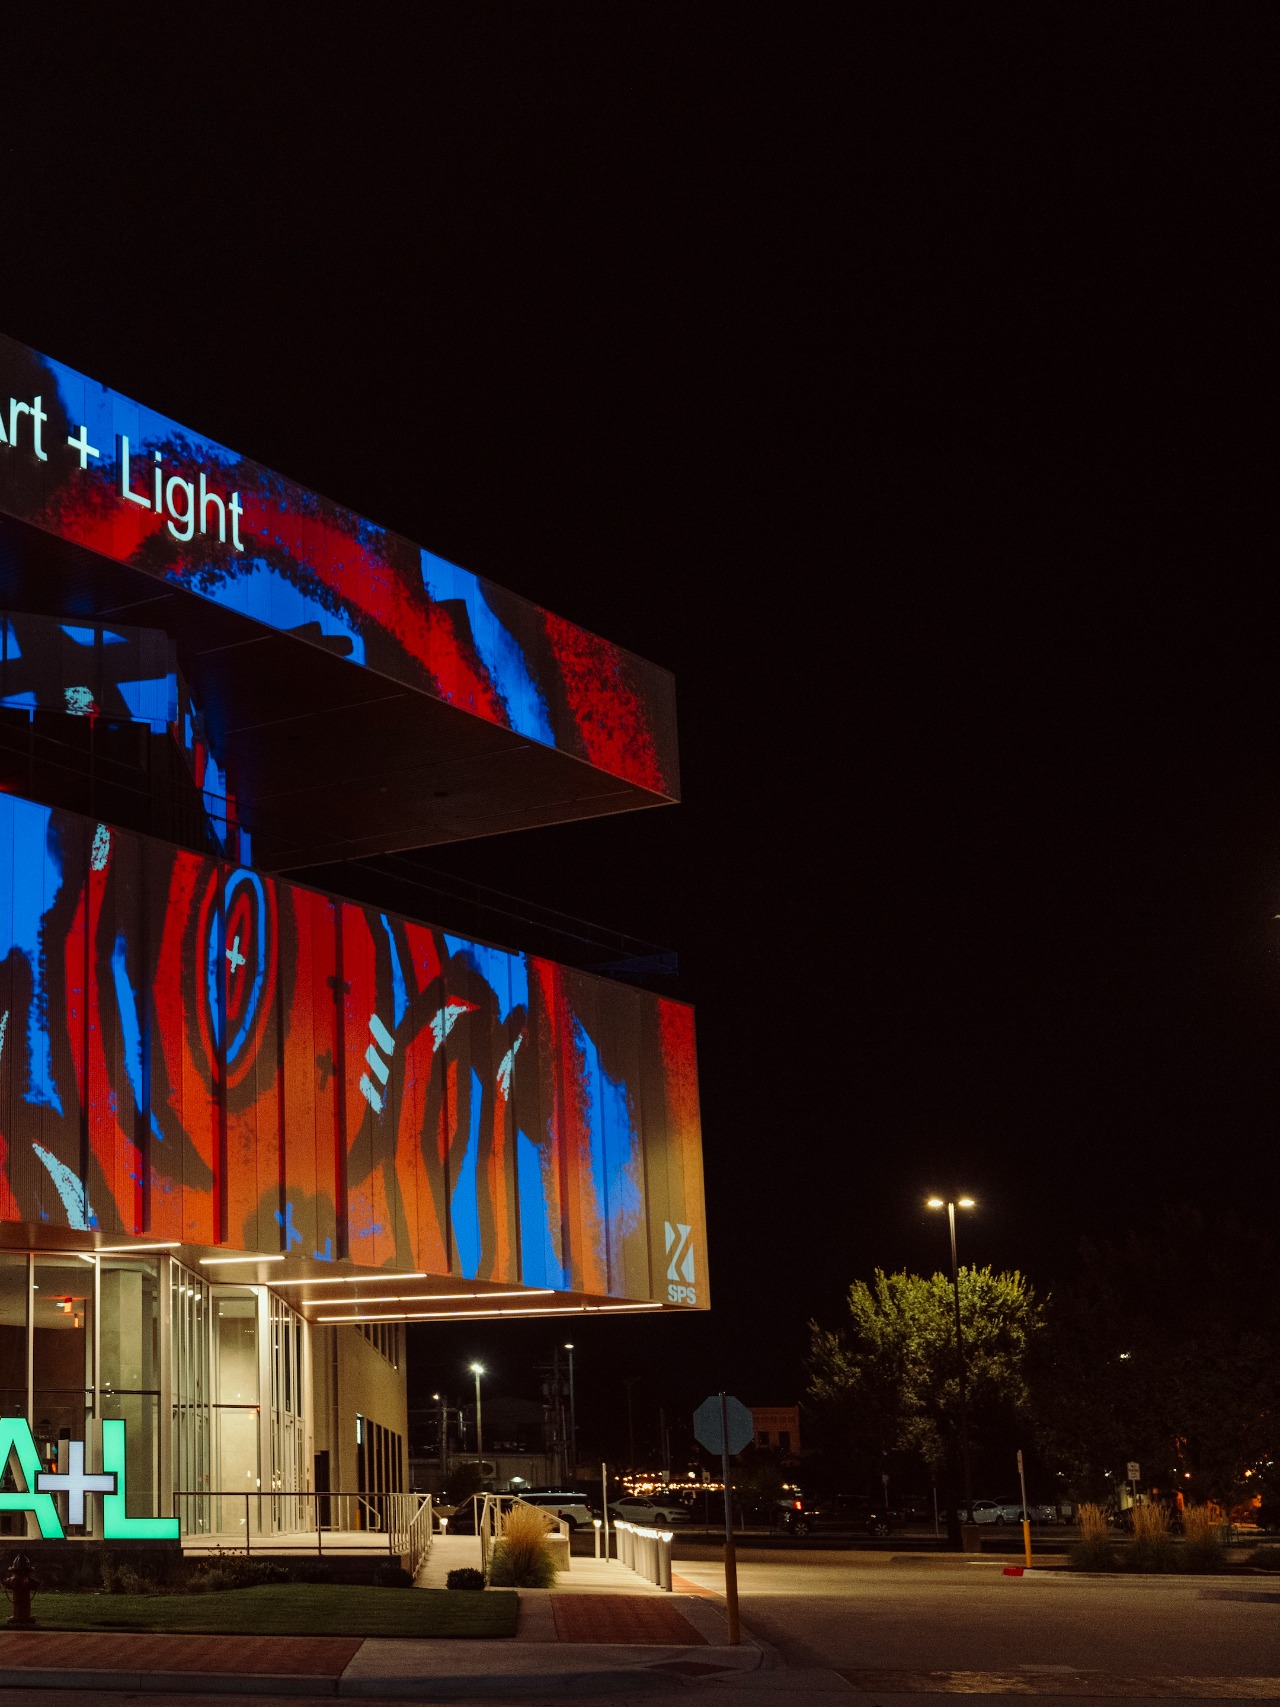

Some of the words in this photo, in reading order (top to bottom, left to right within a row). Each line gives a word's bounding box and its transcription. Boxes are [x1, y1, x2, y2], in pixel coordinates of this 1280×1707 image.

[67, 425, 100, 470] +
[122, 434, 246, 552] Light
[667, 1284, 697, 1305] SPS
